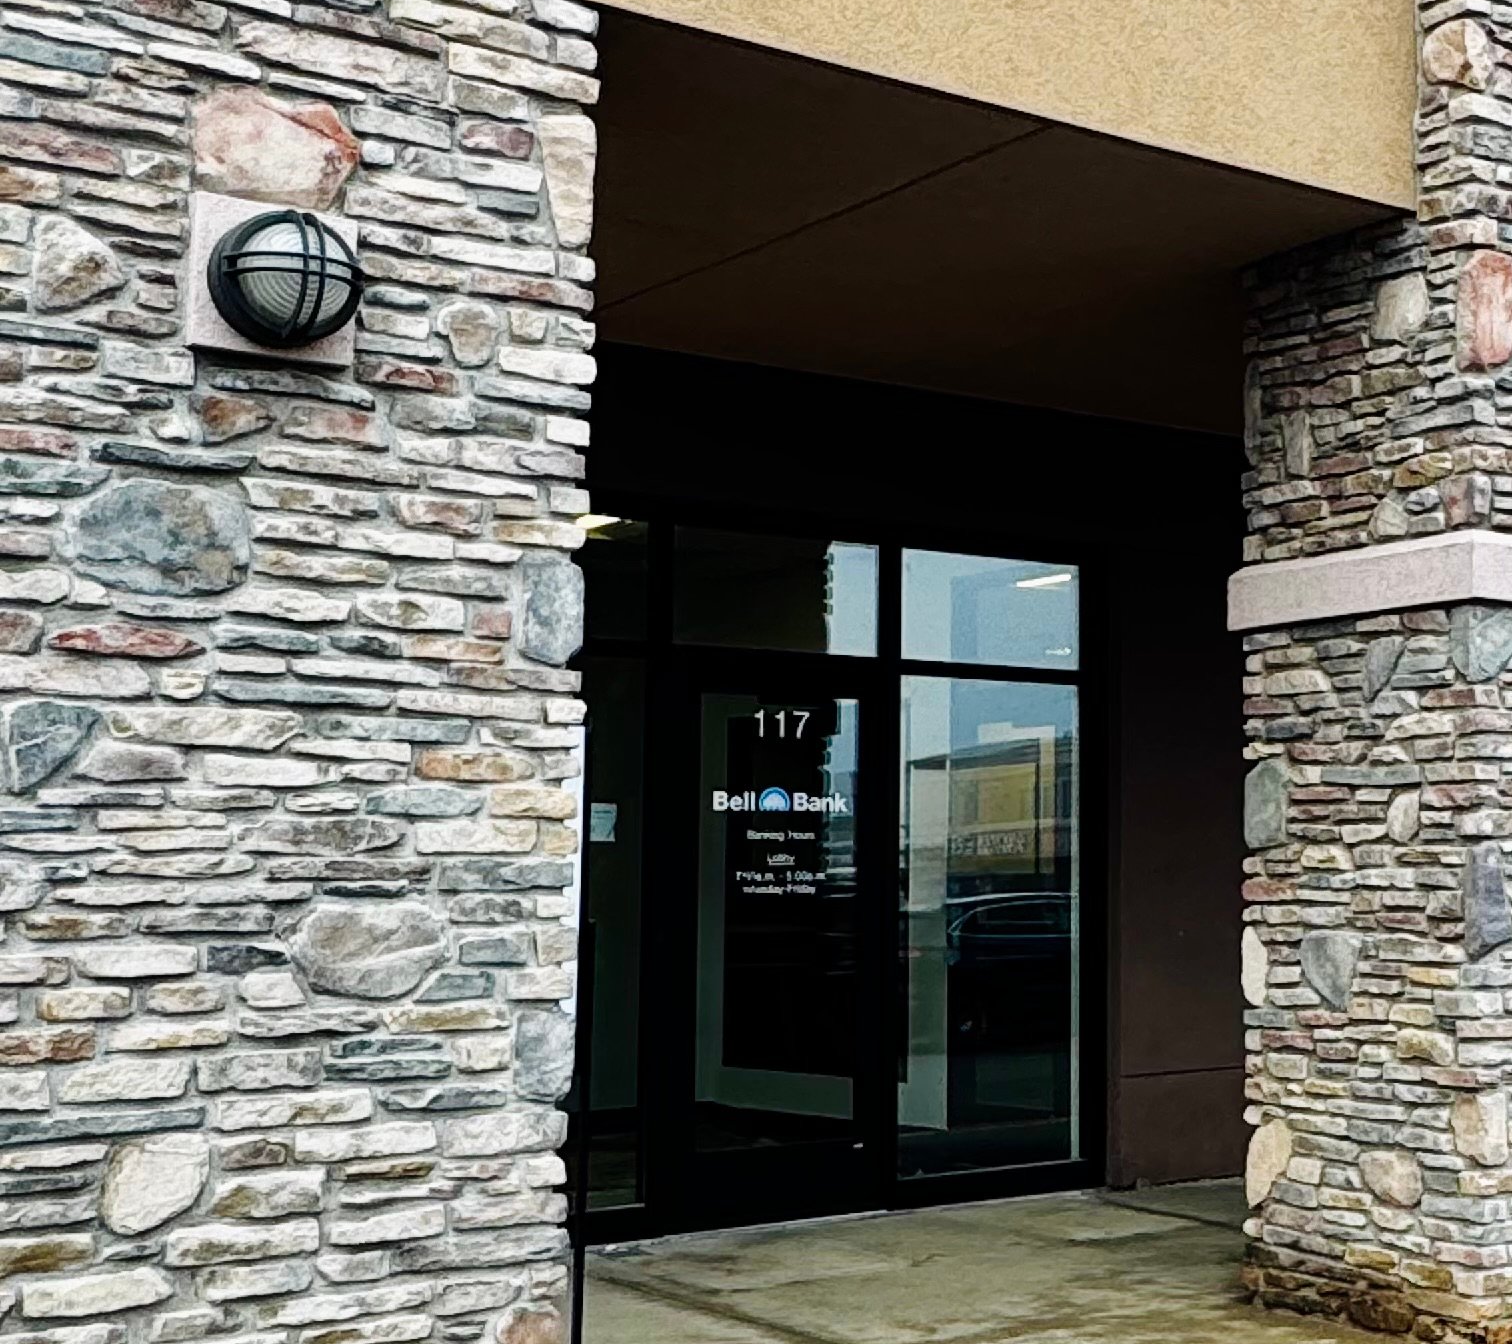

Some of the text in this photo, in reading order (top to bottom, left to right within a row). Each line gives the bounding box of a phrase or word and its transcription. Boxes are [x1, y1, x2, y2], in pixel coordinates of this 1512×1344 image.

[754, 709, 810, 739] 117
[712, 791, 848, 812] Bell Bank
